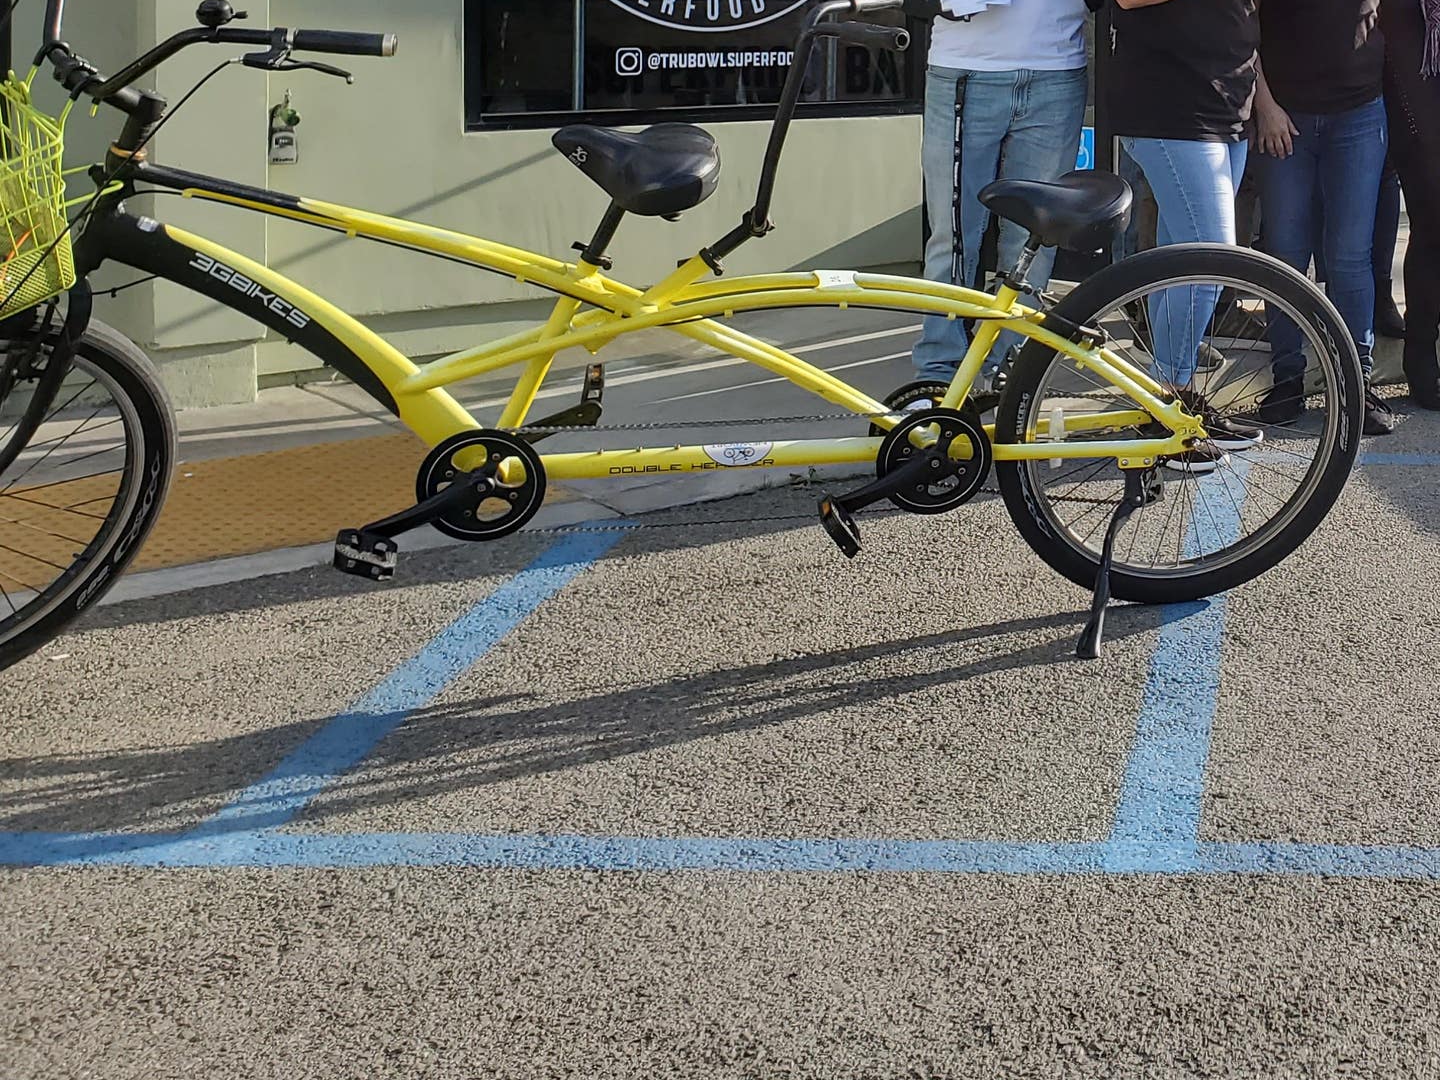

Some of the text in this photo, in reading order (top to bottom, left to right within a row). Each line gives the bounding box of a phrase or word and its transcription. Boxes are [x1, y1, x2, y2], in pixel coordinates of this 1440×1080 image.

[647, 51, 794, 71] @TRUBOWLSUPERFOO
[188, 252, 311, 330] 3GBIKES
[609, 463, 682, 475] DOUBLE
